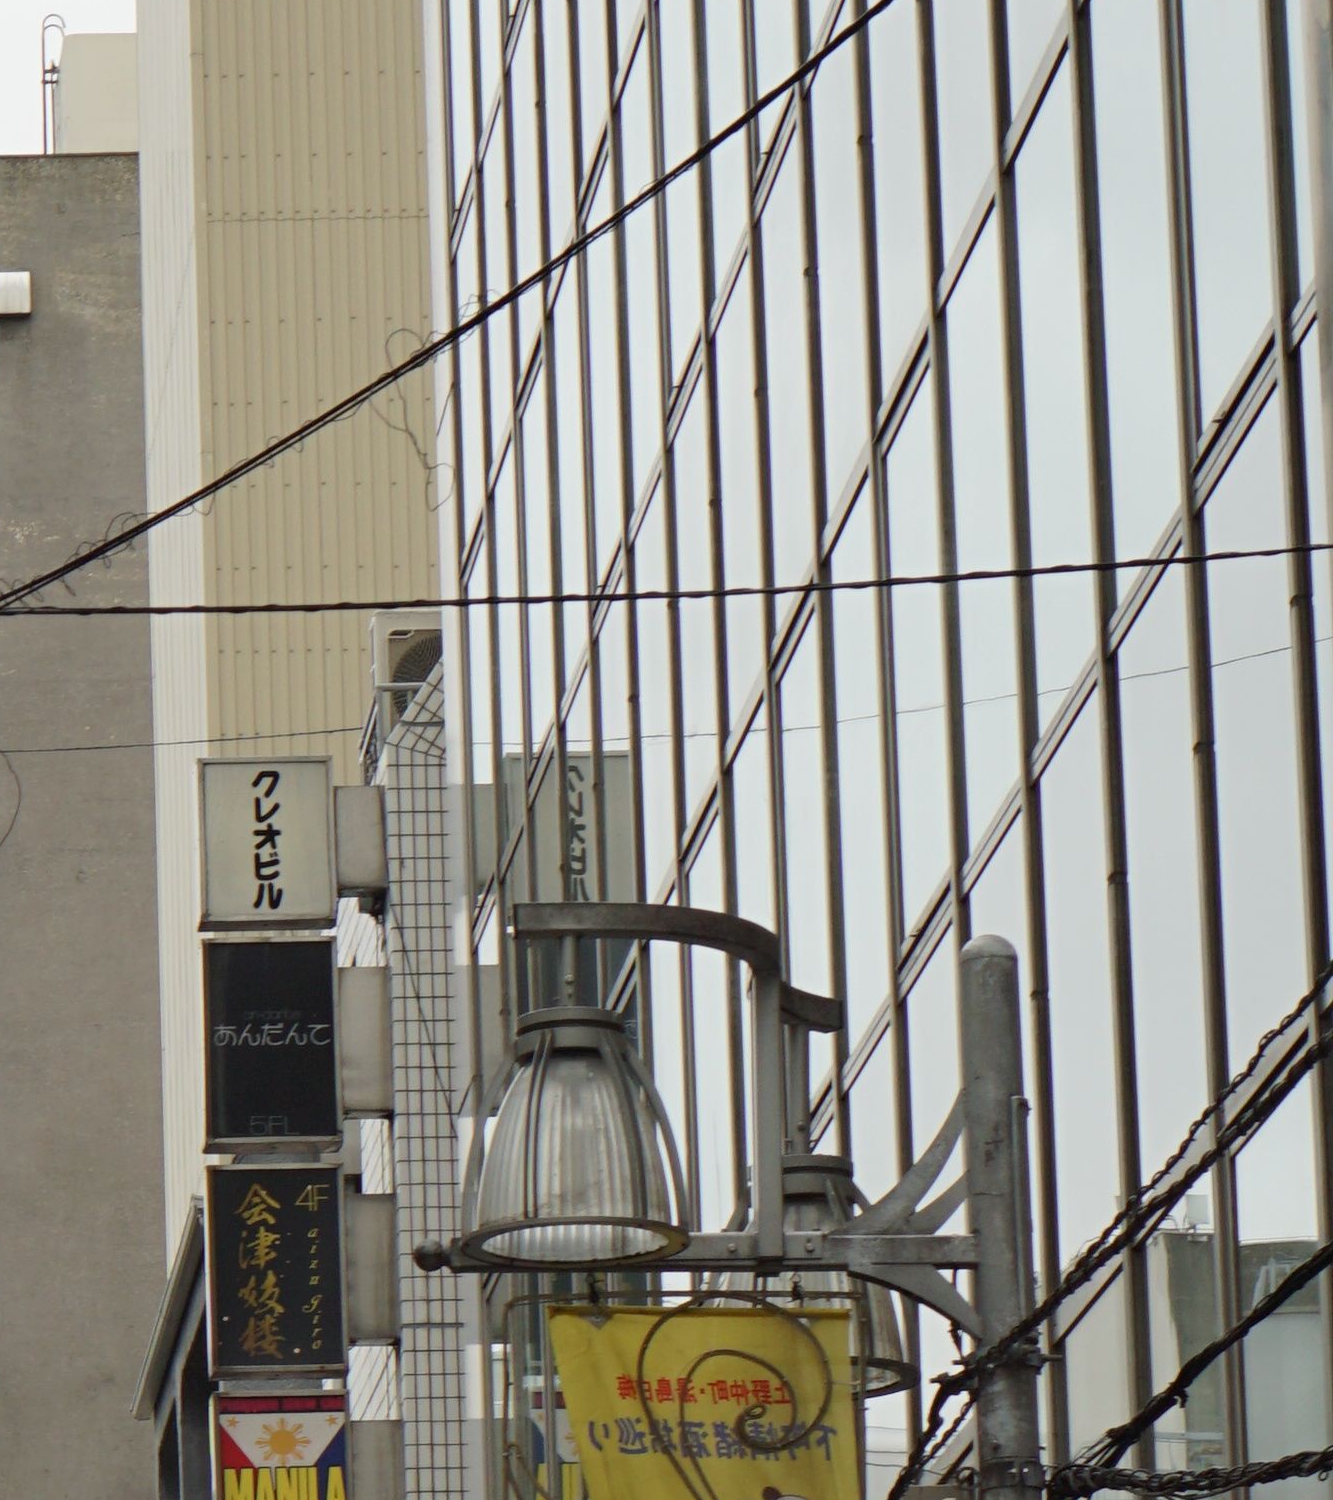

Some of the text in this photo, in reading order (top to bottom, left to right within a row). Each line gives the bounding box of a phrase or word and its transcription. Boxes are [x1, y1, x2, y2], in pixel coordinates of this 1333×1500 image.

[251, 770, 283, 910] クレオビル
[212, 1022, 332, 1047] あんだんて
[249, 1115, 300, 1138] 5FL
[294, 1183, 330, 1213] 4F
